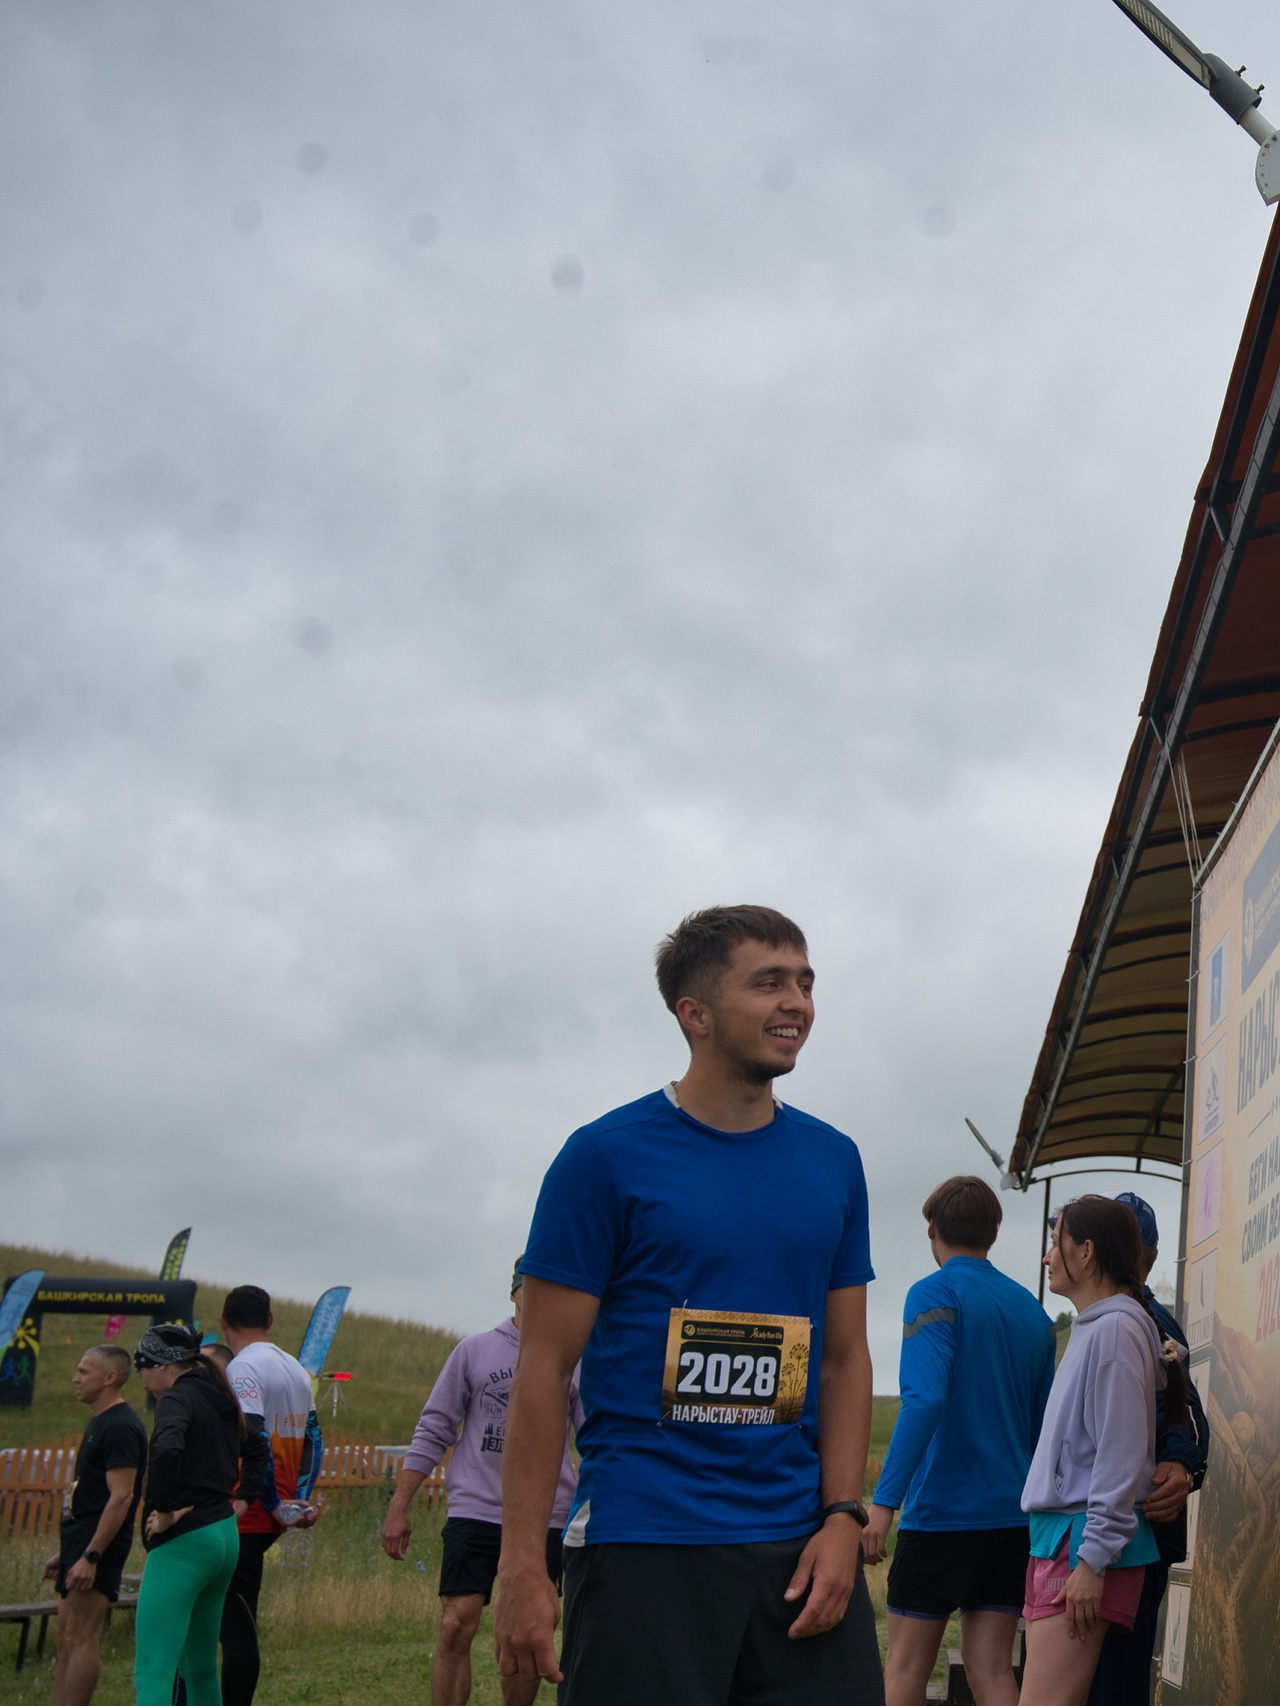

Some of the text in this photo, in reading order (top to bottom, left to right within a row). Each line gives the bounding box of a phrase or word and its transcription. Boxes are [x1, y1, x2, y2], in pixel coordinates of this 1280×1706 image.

[1248, 1148, 1267, 1205] БЕГИ
[1241, 1204, 1269, 1265] СВОИМ
[37, 1290, 165, 1304] БАШКИРСКАЯ ТРОПА
[489, 1367, 513, 1384] ВЫ
[677, 1351, 777, 1397] 2028
[672, 1404, 775, 1425] НАРЫСТАУ-ТРЕЙЛ
[489, 1440, 503, 1451] ЭЛ
